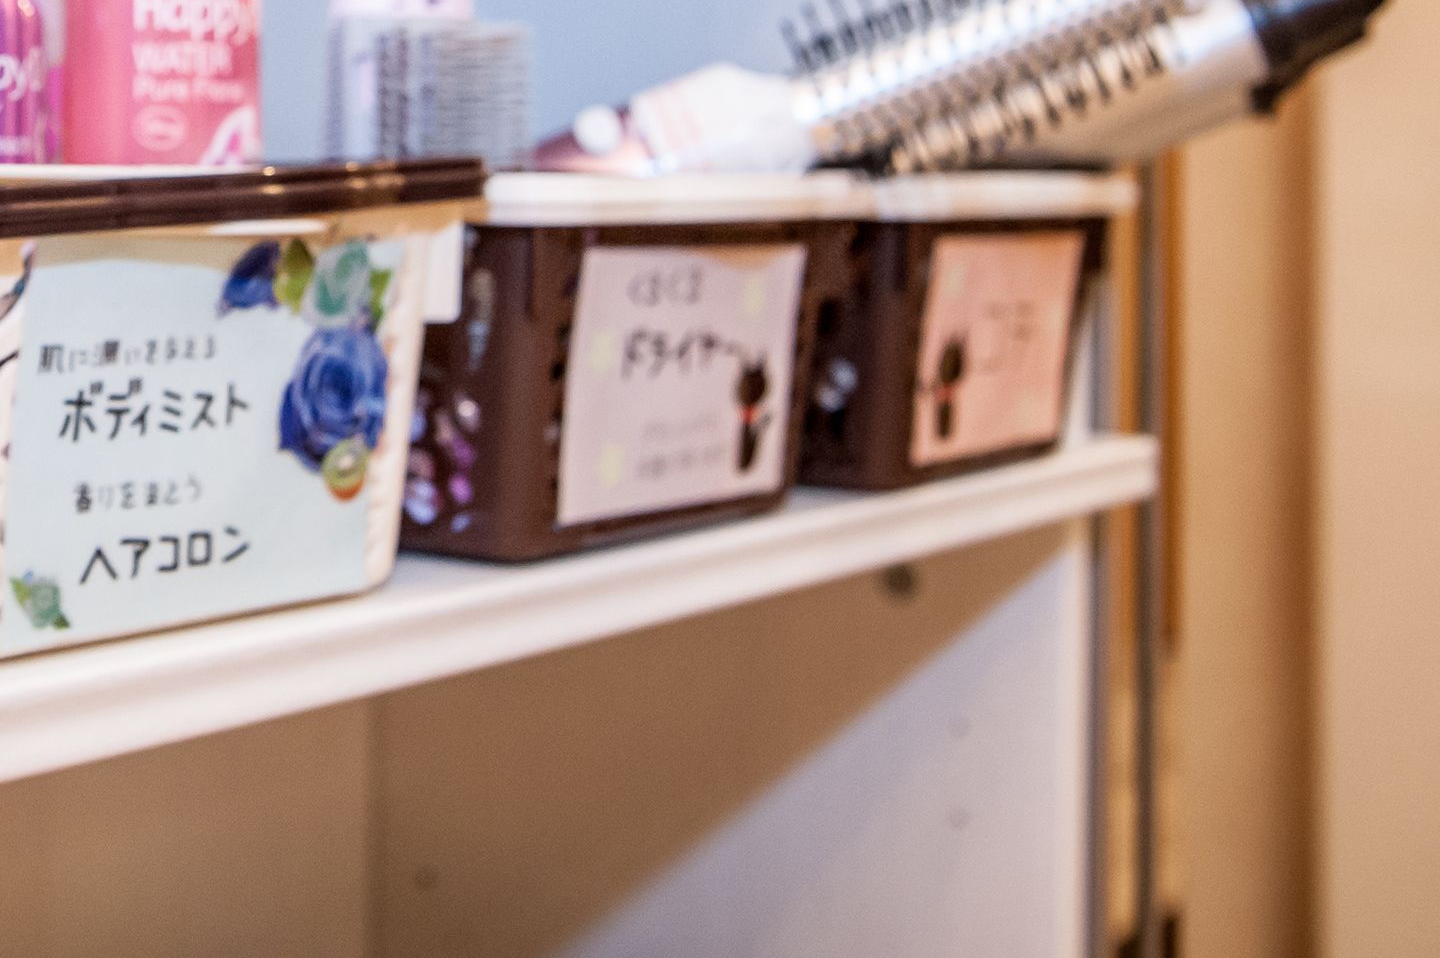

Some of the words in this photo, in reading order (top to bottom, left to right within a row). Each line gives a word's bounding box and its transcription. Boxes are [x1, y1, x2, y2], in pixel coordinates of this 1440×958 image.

[58, 377, 250, 443] ボディミスト
[78, 525, 250, 585] ヘアコロン
